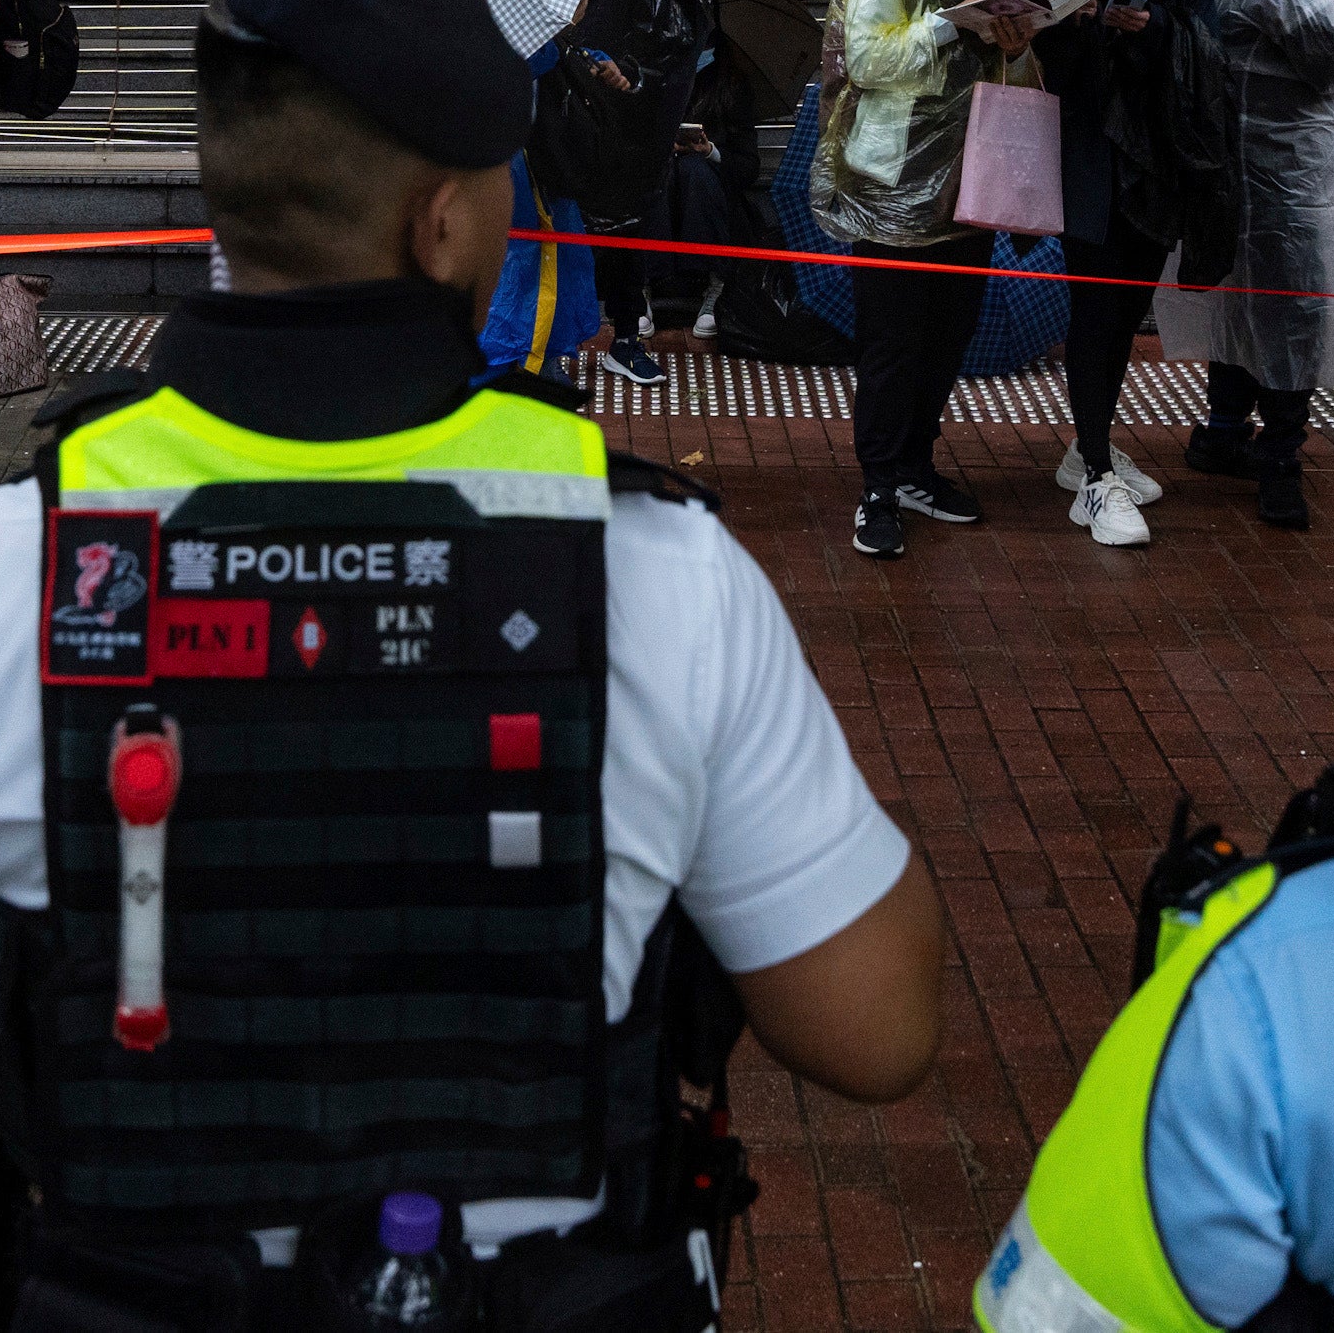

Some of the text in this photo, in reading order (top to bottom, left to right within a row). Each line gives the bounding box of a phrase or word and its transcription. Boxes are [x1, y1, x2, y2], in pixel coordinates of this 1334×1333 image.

[168, 537, 451, 590] 警 POLICE 察
